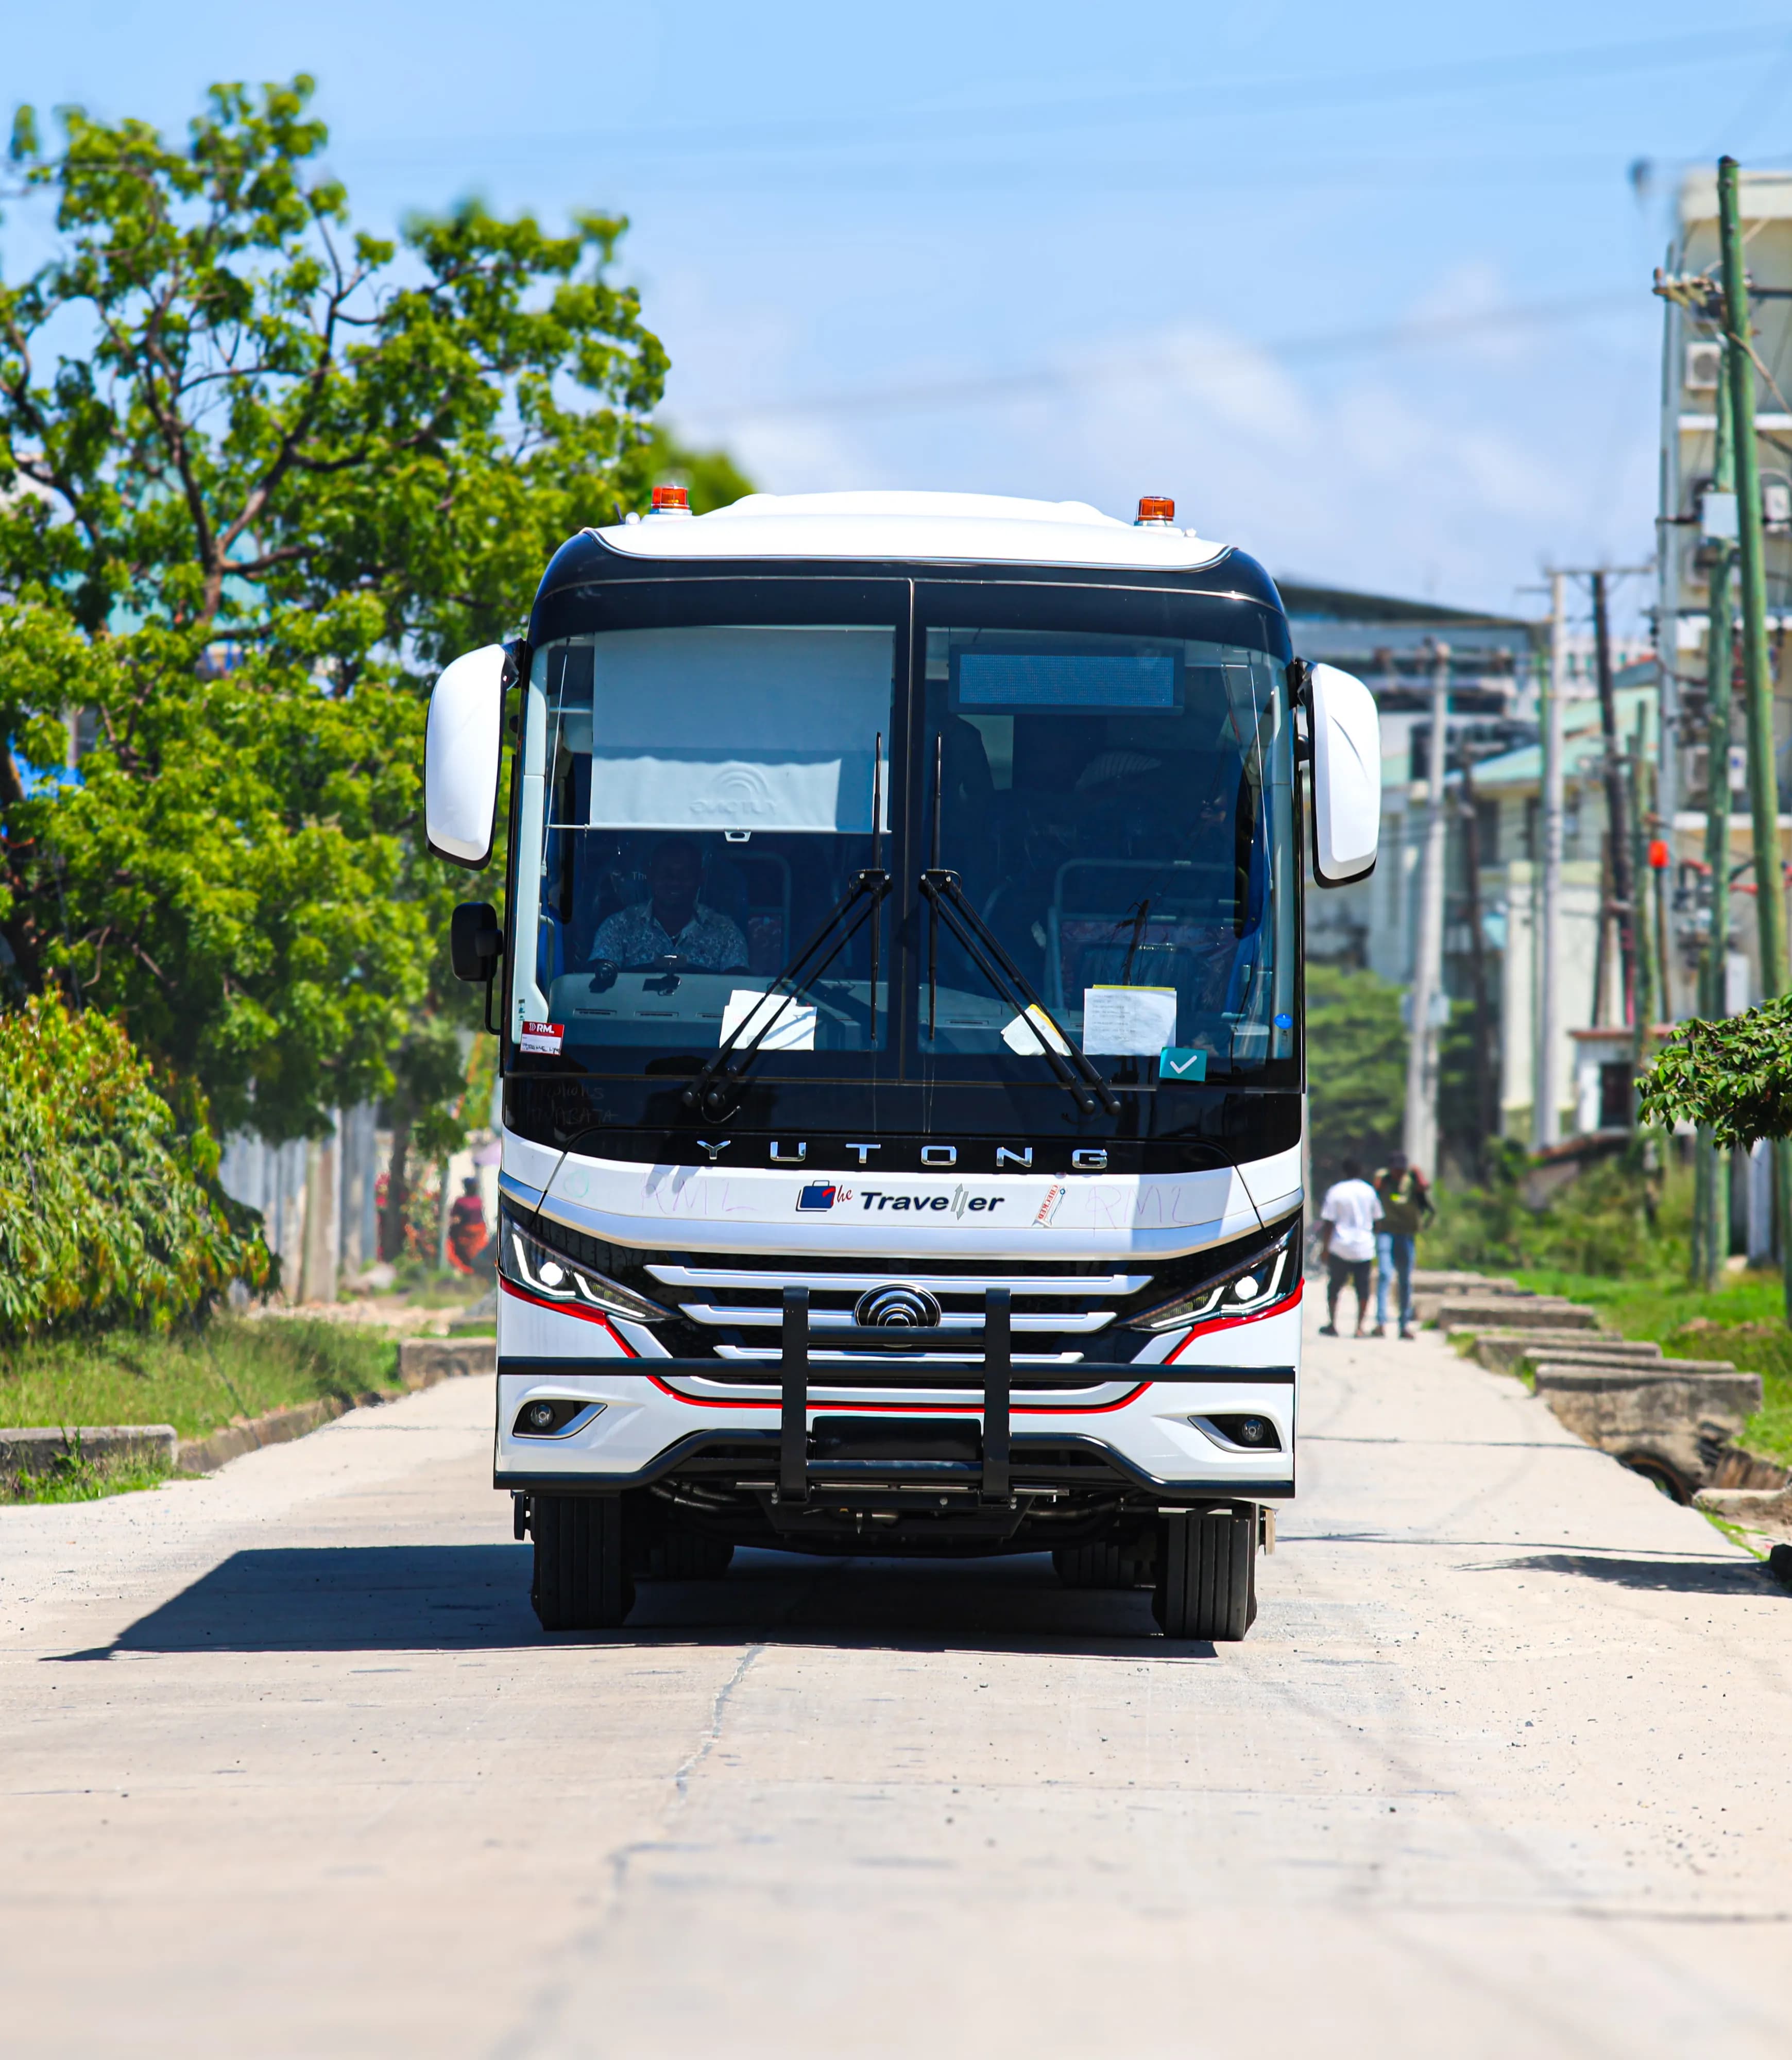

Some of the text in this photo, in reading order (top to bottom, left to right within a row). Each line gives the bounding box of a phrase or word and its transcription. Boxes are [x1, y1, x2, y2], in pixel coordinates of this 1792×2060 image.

[536, 1023, 555, 1035] RML
[697, 1140, 1107, 1169] YUTONG
[861, 1183, 1005, 1221] Traveller
[1038, 1184, 1059, 1220] CHECKED
